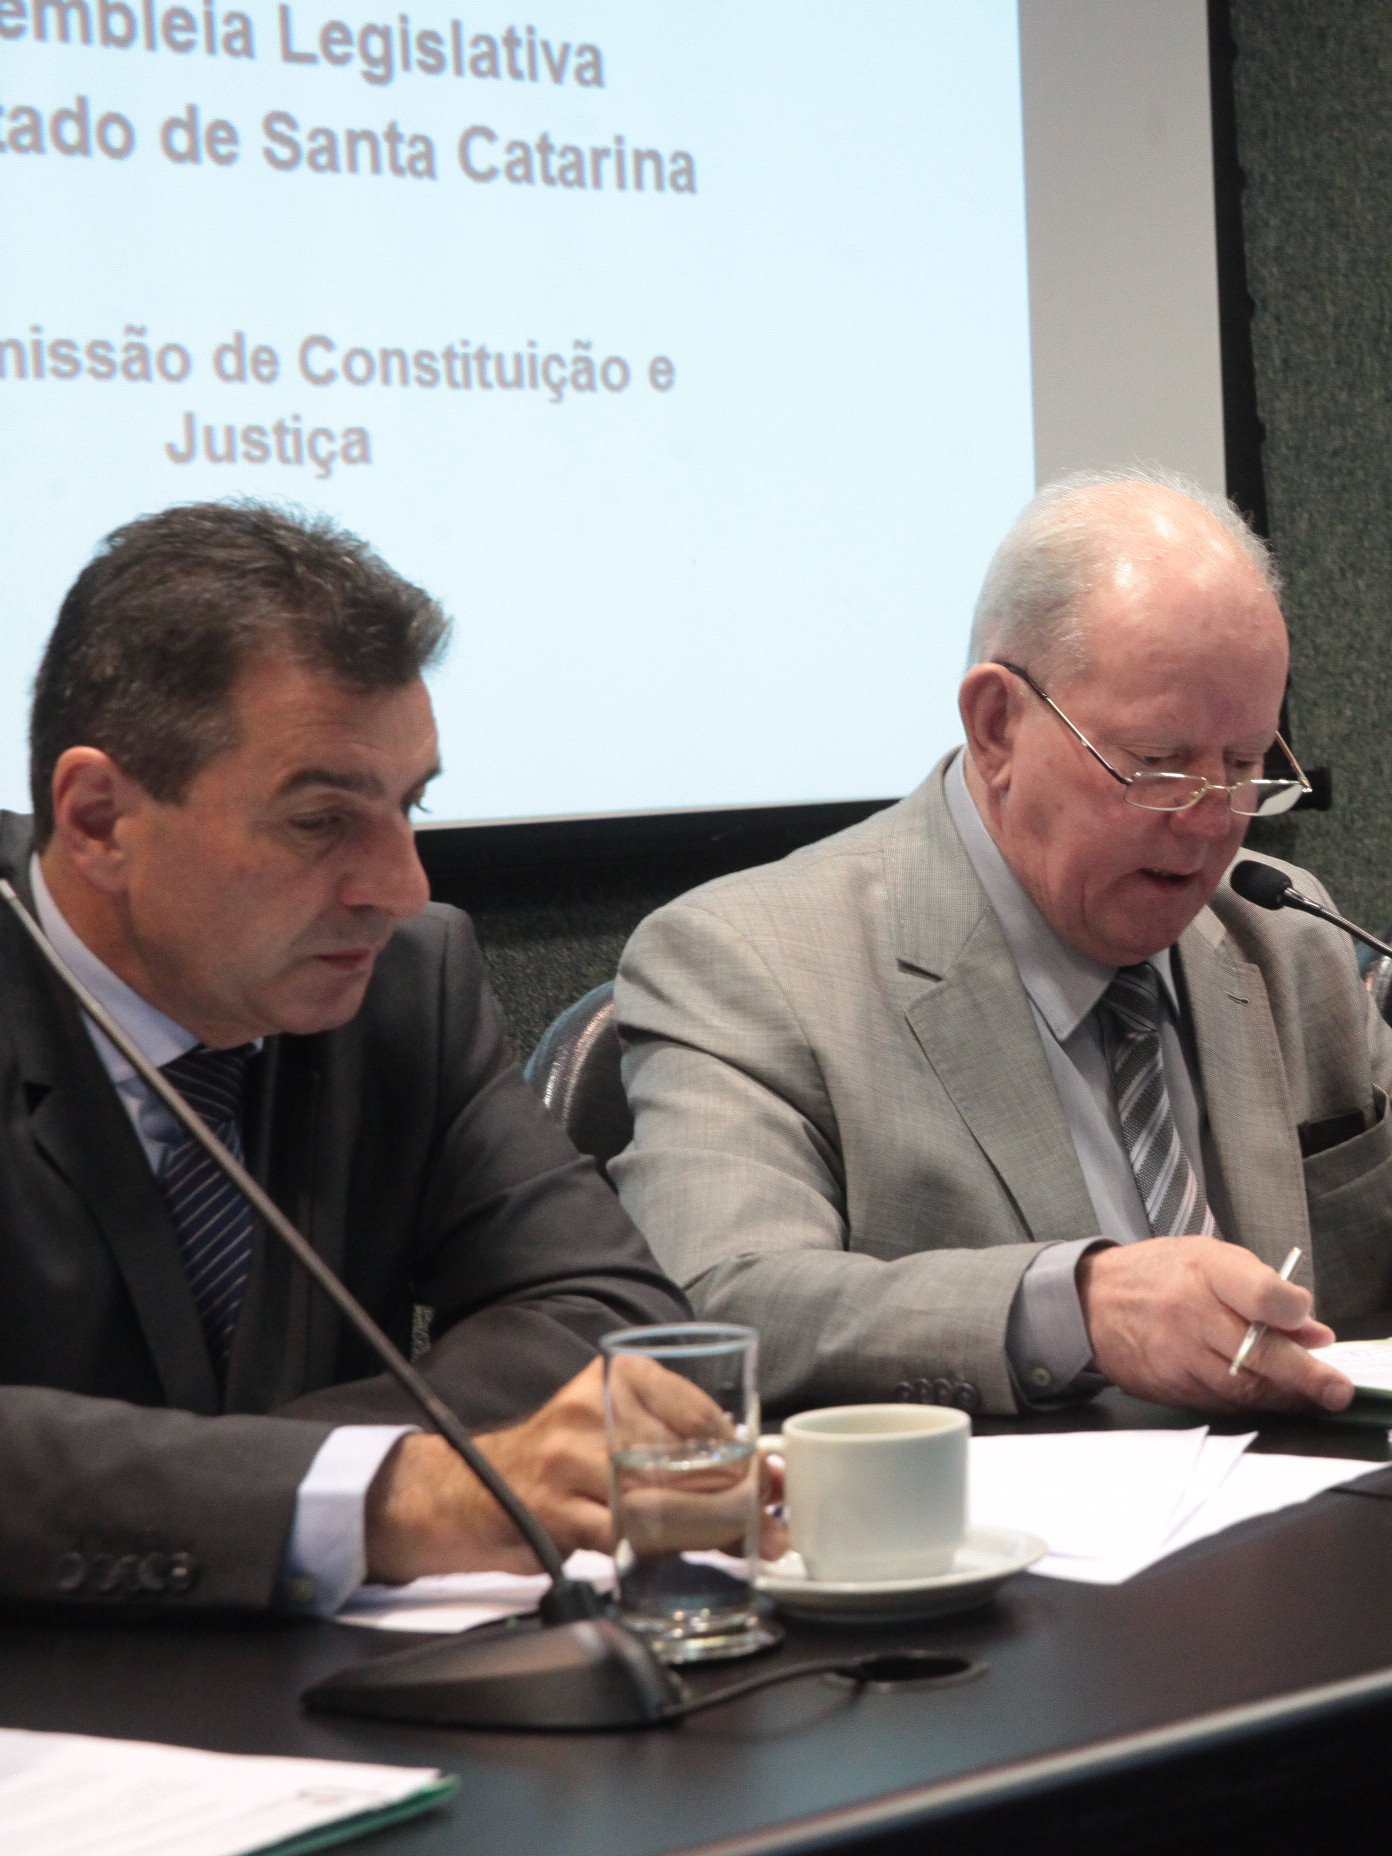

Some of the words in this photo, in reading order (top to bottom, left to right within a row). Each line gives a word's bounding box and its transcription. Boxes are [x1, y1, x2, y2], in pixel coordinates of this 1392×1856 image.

[279, 3, 606, 88] Legislativa
[0, 94, 137, 161] ado
[161, 103, 241, 166] de
[263, 110, 438, 180] Santa
[458, 124, 697, 194] Catarina
[214, 331, 280, 384] de
[299, 334, 632, 402] Constituição
[648, 355, 676, 392] e
[166, 410, 373, 479] Justiça
